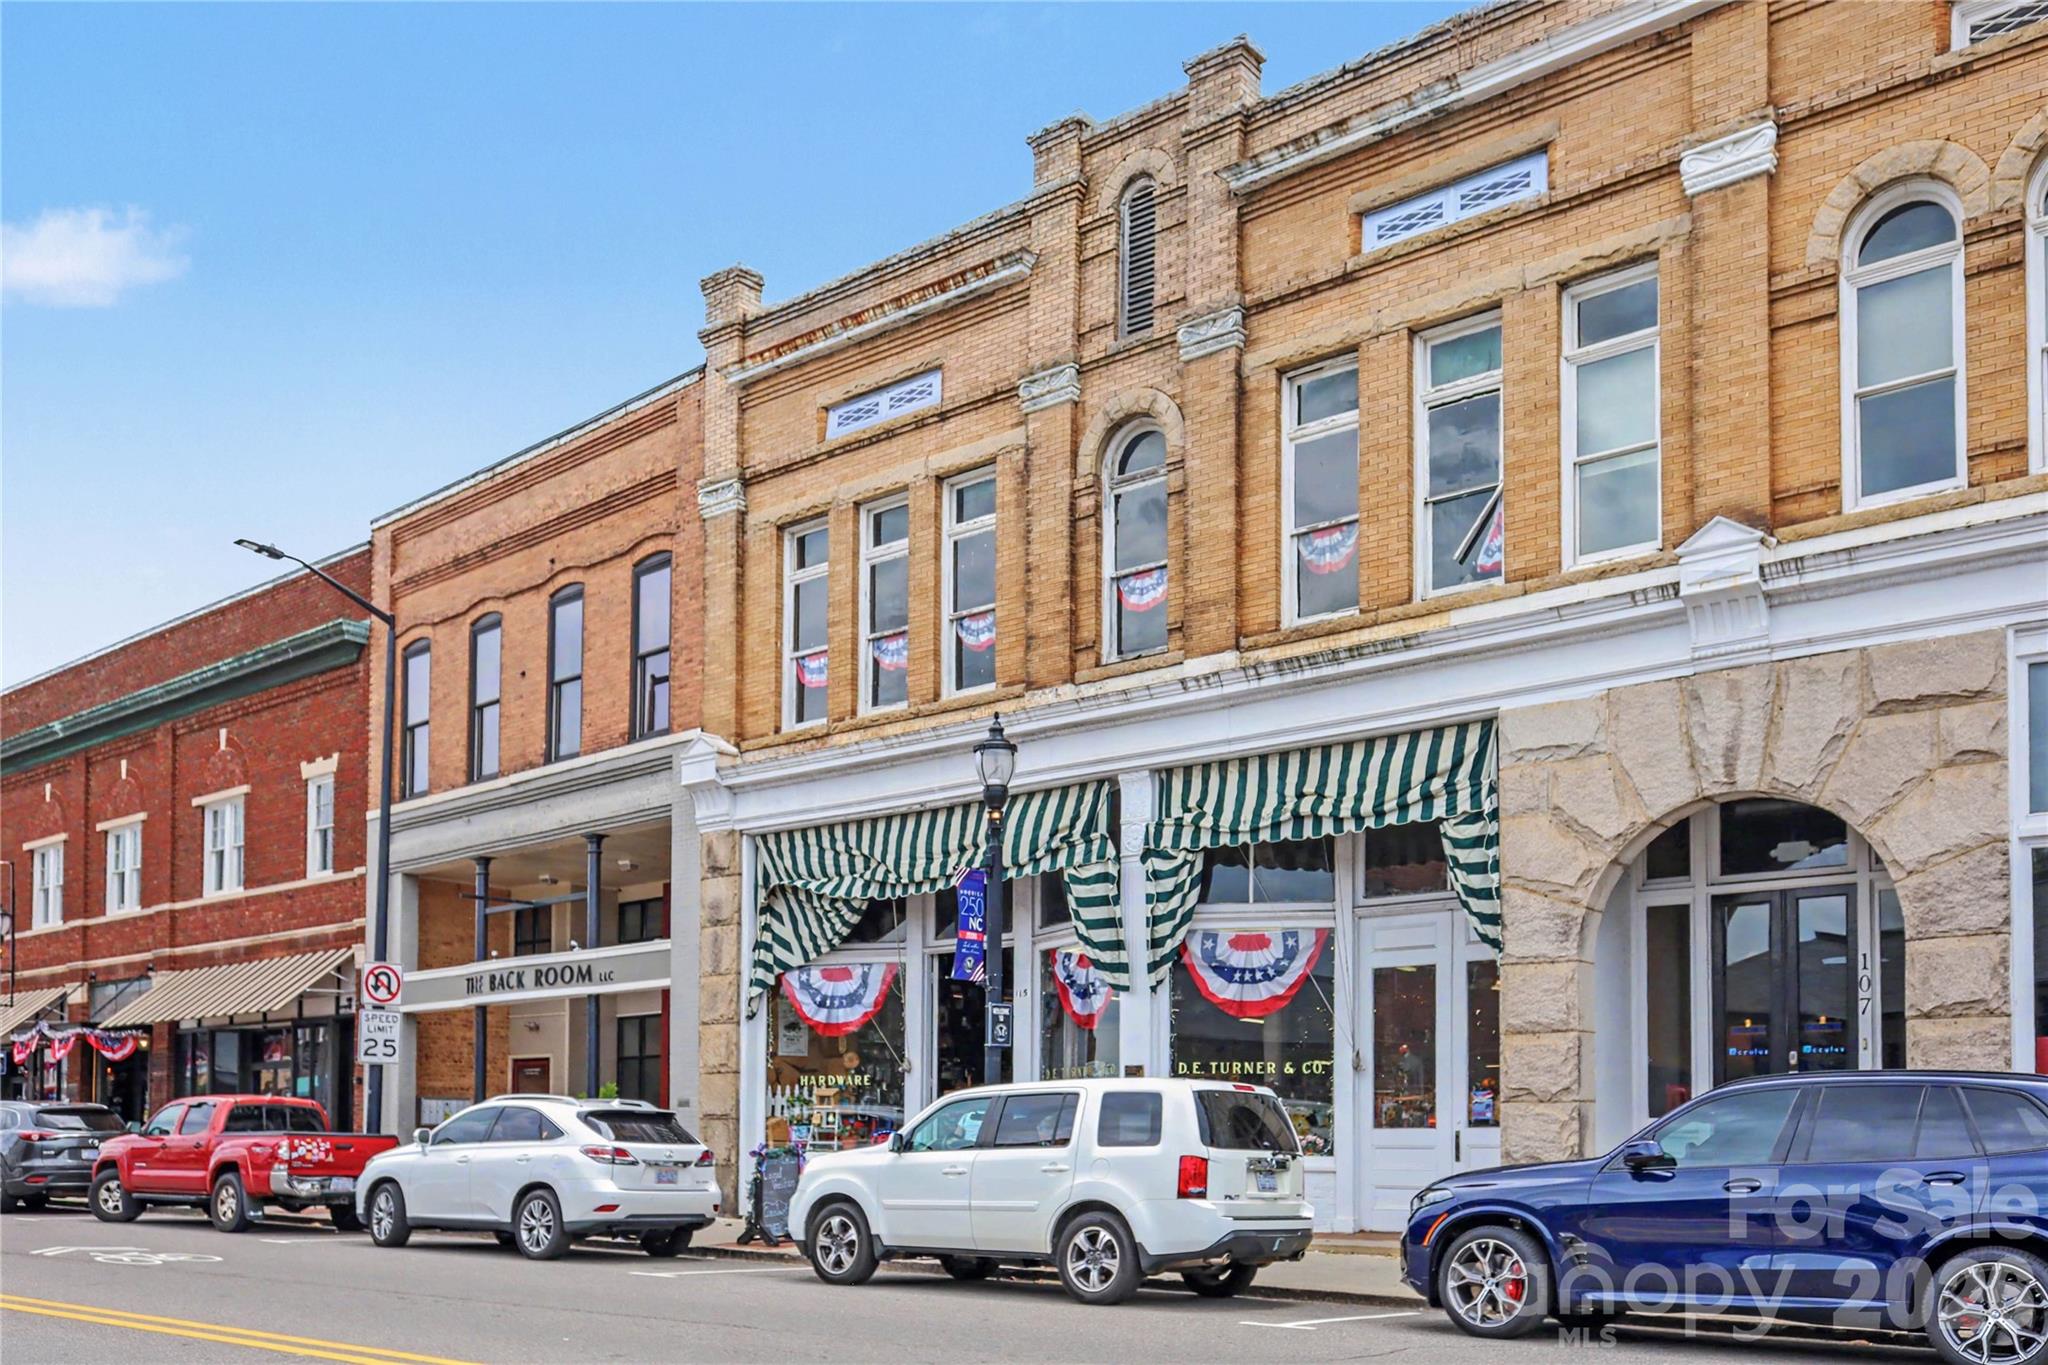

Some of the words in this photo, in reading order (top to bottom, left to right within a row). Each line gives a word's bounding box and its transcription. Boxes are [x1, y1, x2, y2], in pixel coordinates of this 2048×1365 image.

[960, 895, 984, 917] 250
[968, 916, 983, 931] NC
[489, 970, 525, 991] BACK
[534, 964, 592, 988] ROOM
[599, 971, 614, 982] LLC
[1859, 953, 1872, 1015] 107
[364, 1013, 398, 1024] SPEED
[367, 1025, 394, 1034] LIMIT
[363, 1038, 397, 1058] 25
[1178, 1061, 1205, 1075] D.E.
[1210, 1061, 1276, 1075] TURNER
[1284, 1061, 1296, 1074] &
[800, 1074, 871, 1086] HARDWARE
